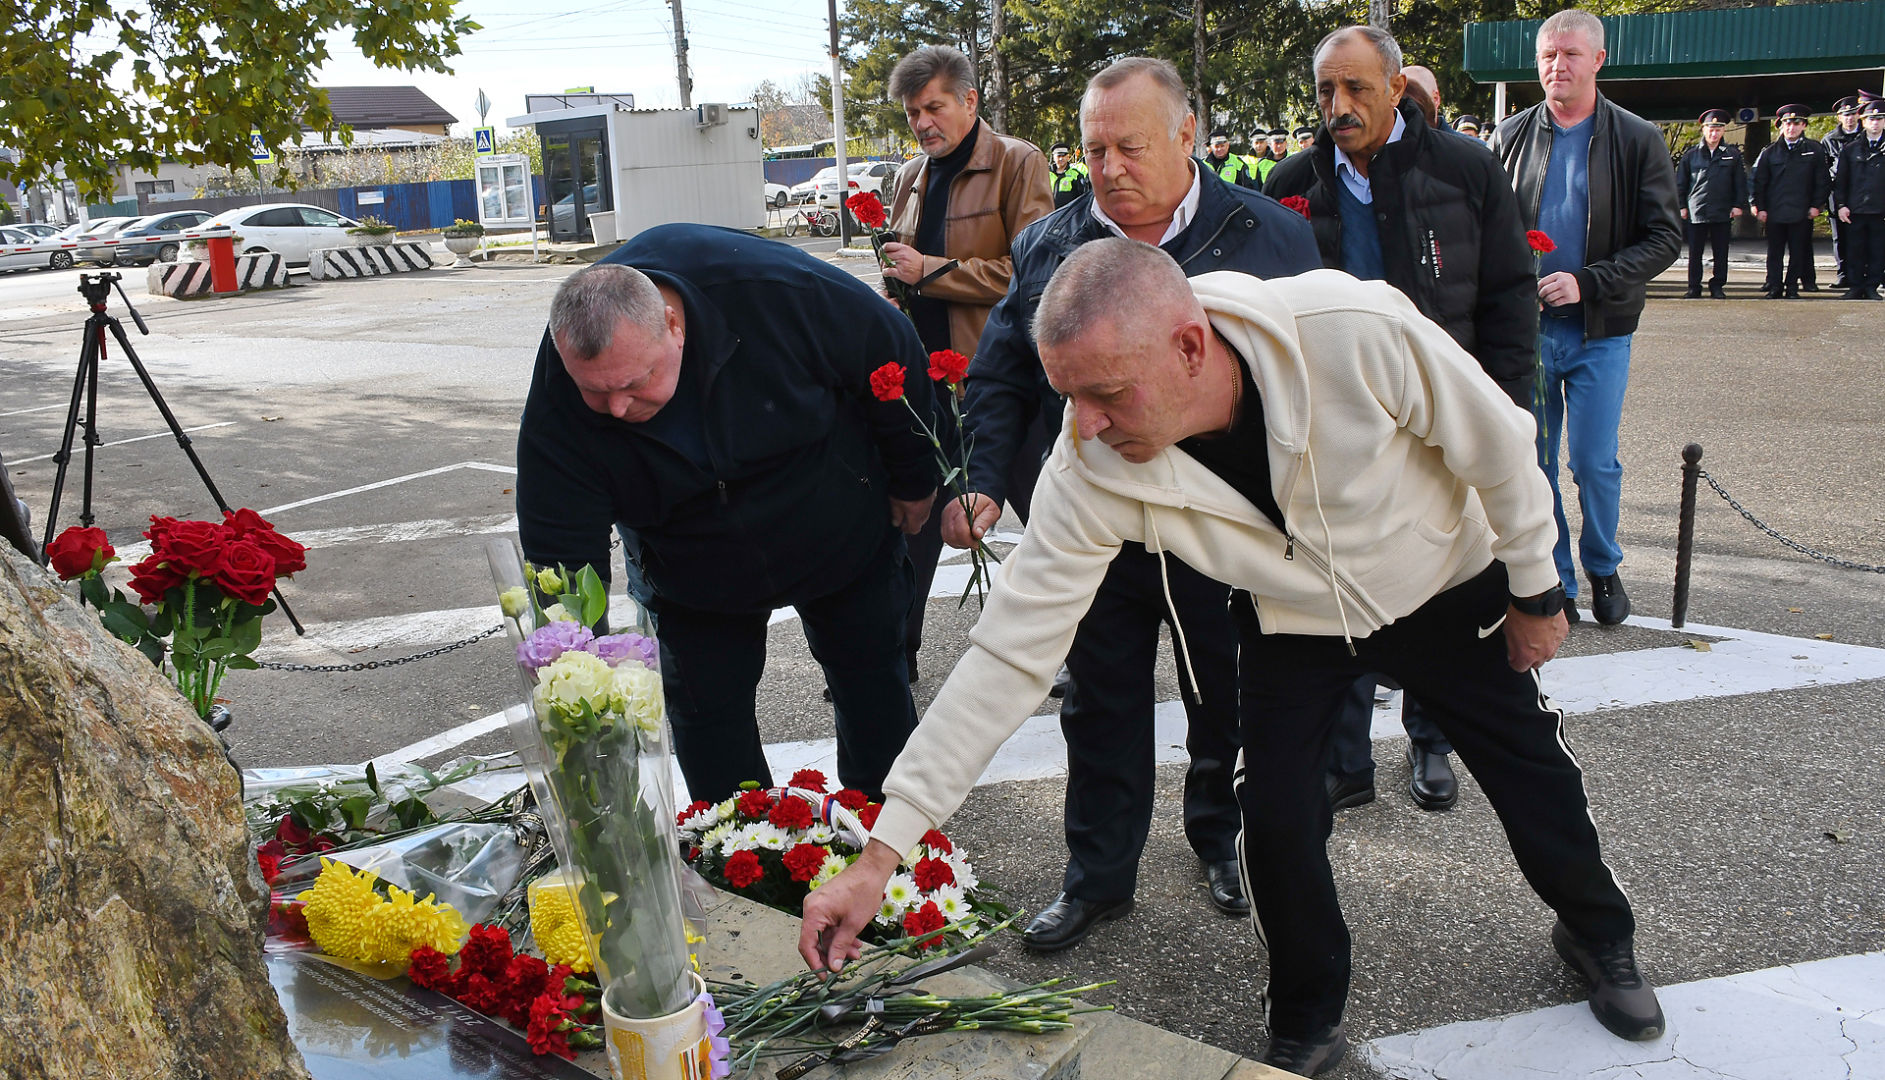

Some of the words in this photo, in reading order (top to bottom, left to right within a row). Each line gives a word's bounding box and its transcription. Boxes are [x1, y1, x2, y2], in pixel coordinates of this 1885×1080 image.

[356, 1000, 416, 1032] становлен
[437, 1005, 485, 1027] 2011
[844, 1028, 870, 1049] ВЕЧНАЯ
